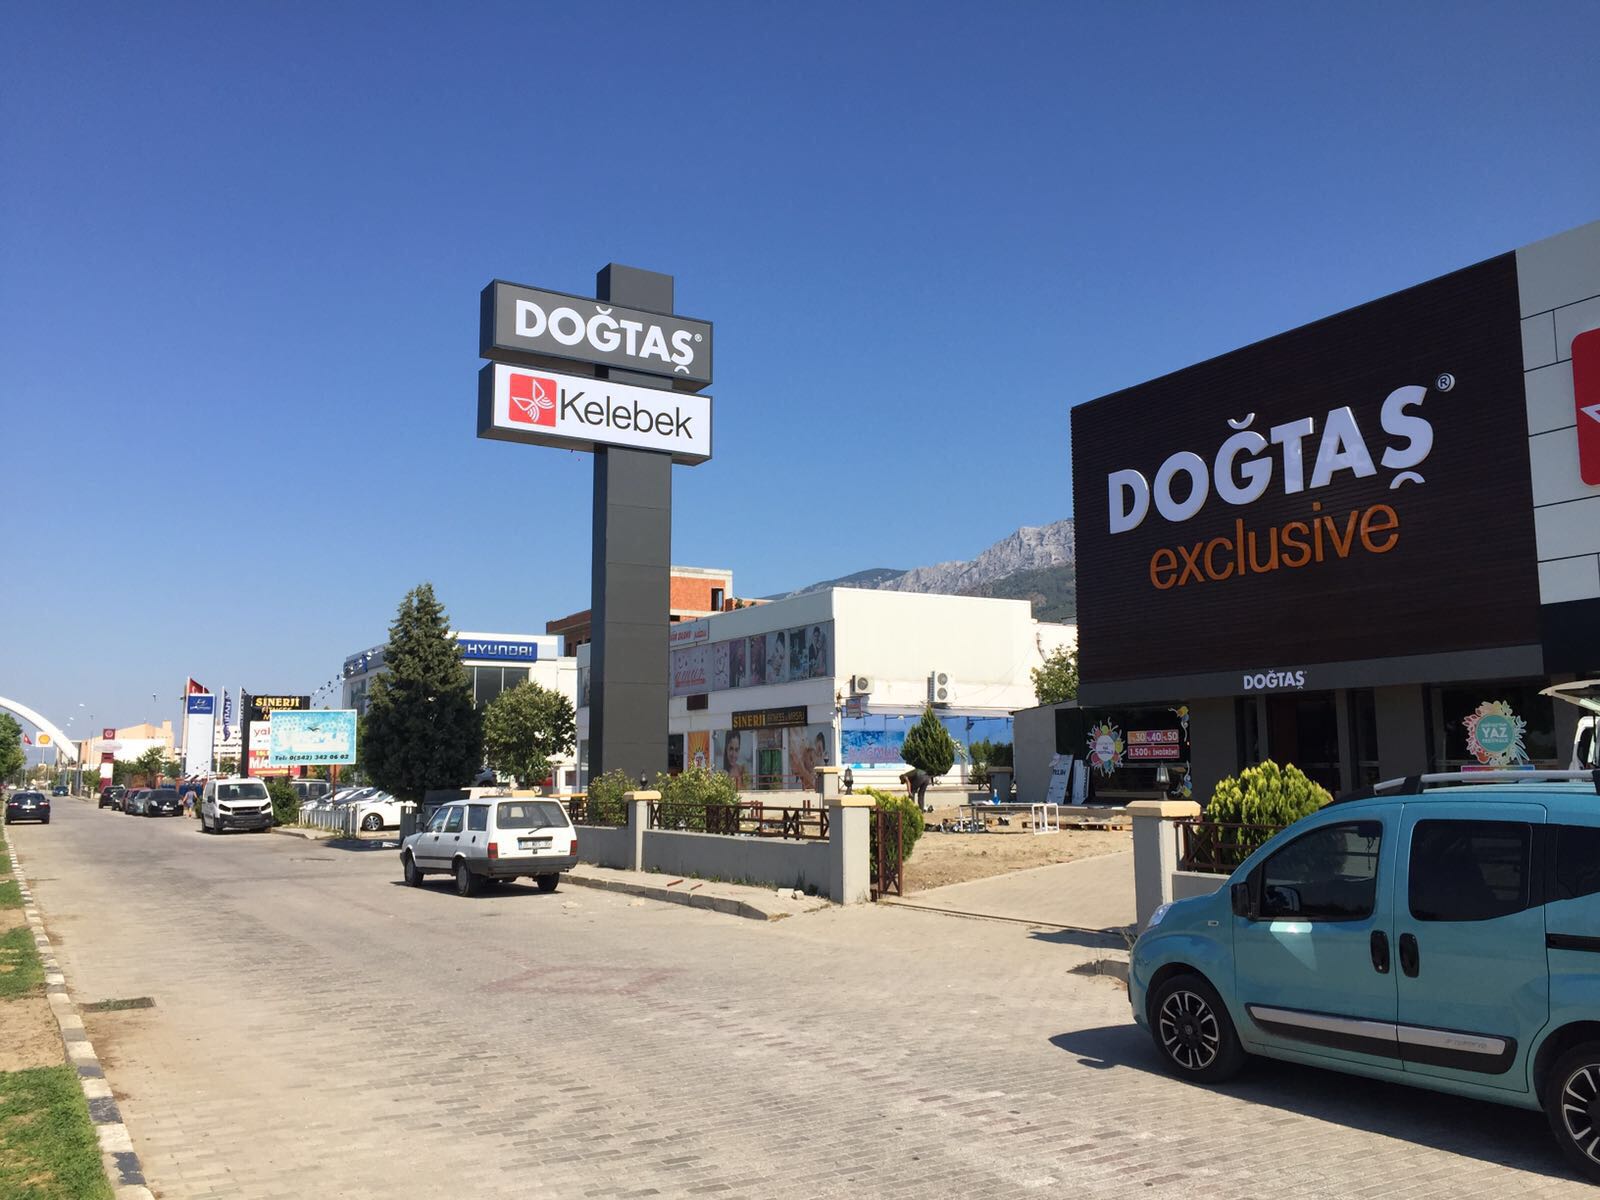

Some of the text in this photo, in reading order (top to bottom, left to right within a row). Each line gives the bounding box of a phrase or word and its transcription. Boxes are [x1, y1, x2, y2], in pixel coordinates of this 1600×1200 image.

[515, 299, 694, 375] DOĞTAŞ
[560, 388, 693, 439] Kelebek
[1107, 384, 1434, 534] DOĞTAŞ
[1150, 501, 1400, 590] exclusive
[467, 643, 532, 657] HYUNDAI
[1243, 669, 1305, 690] DOĞTAŞ
[1481, 727, 1508, 738] YAZ
